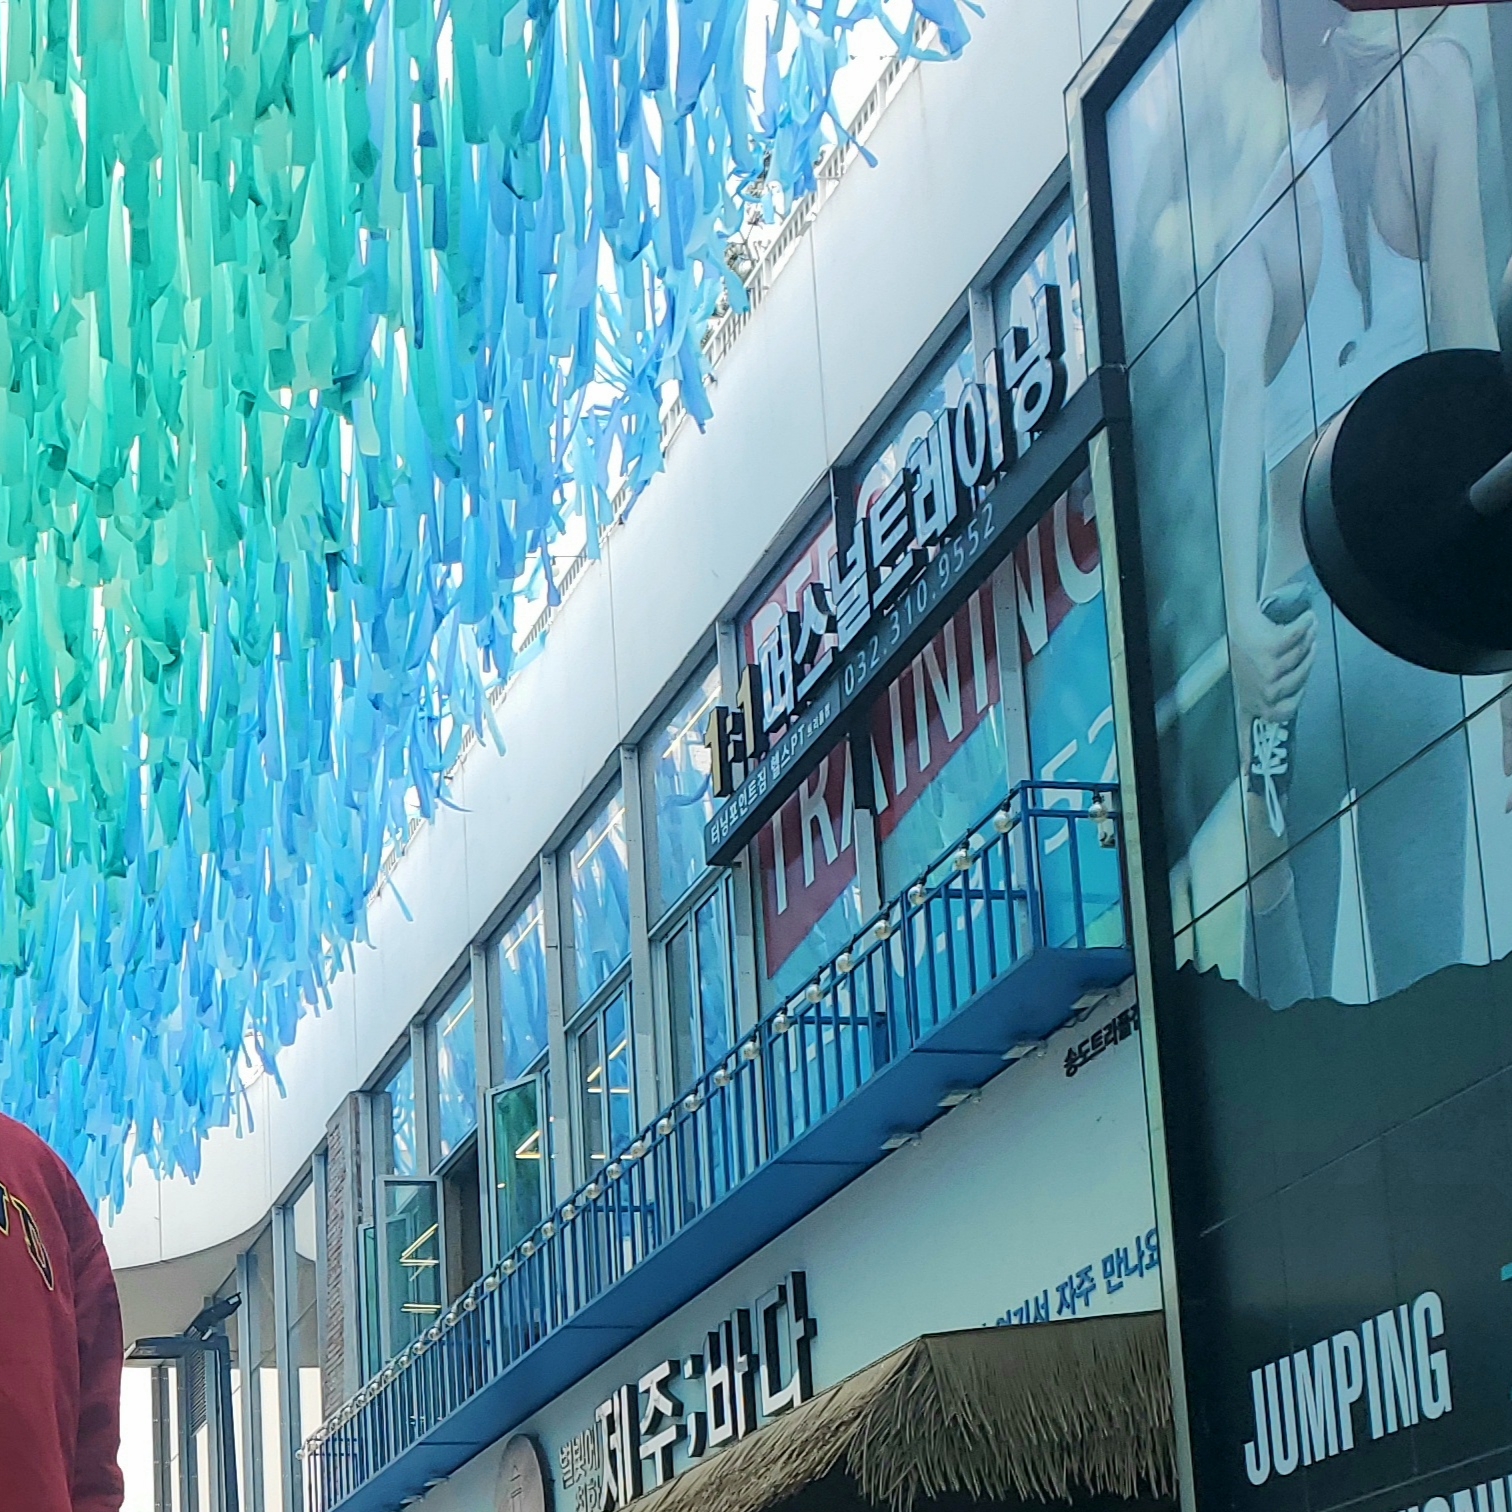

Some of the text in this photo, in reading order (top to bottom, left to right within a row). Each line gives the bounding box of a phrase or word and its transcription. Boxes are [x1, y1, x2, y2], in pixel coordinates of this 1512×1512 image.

[704, 664, 764, 797] 1:1
[759, 284, 1065, 733] 퍼스널트레이닝
[711, 766, 767, 845] 터닝포인트짐
[844, 502, 995, 697] 032.310.9552
[1055, 1264, 1097, 1316] 자주
[1245, 1291, 1453, 1487] JUMPING
